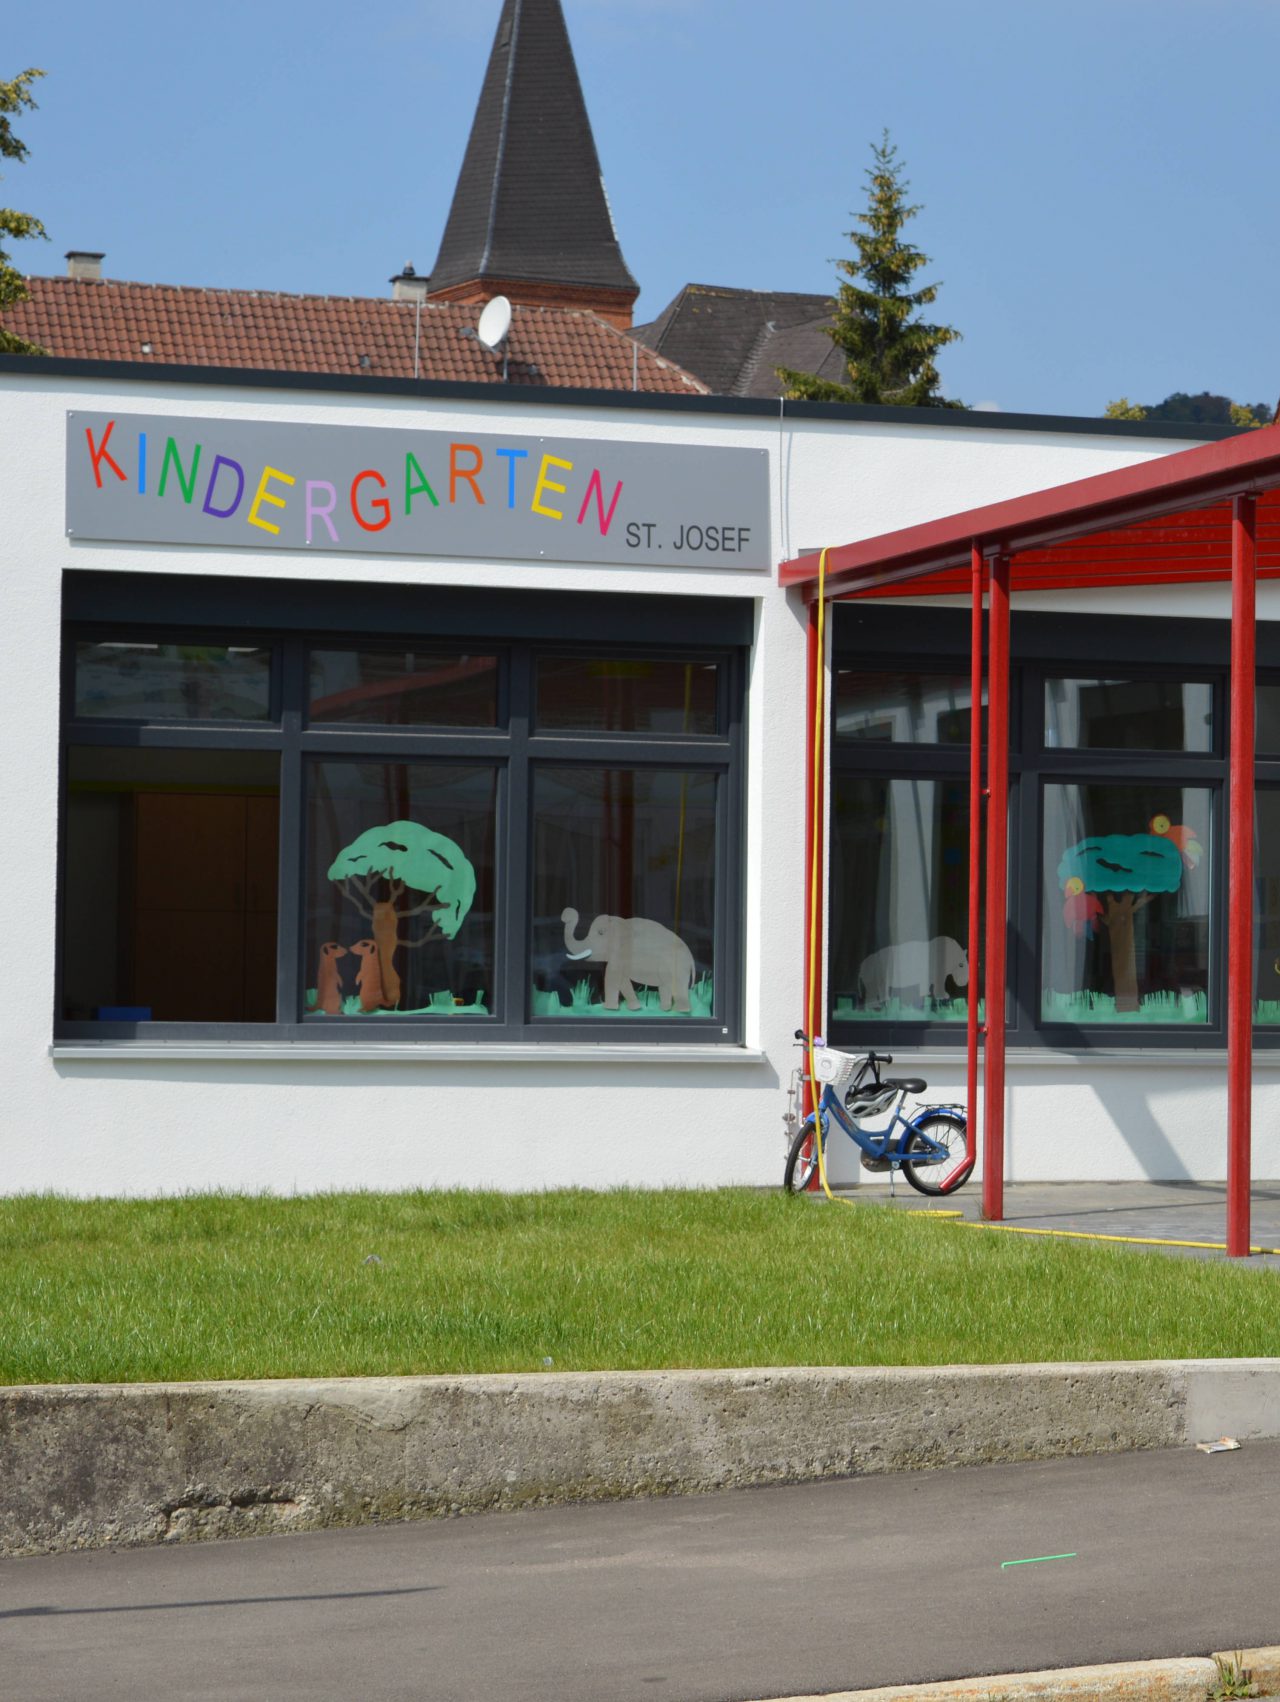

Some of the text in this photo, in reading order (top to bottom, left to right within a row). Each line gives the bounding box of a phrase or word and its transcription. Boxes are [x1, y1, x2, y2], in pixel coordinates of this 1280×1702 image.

[85, 420, 624, 542] KINDERGARTEN
[626, 523, 751, 552] ST. JOSEF
